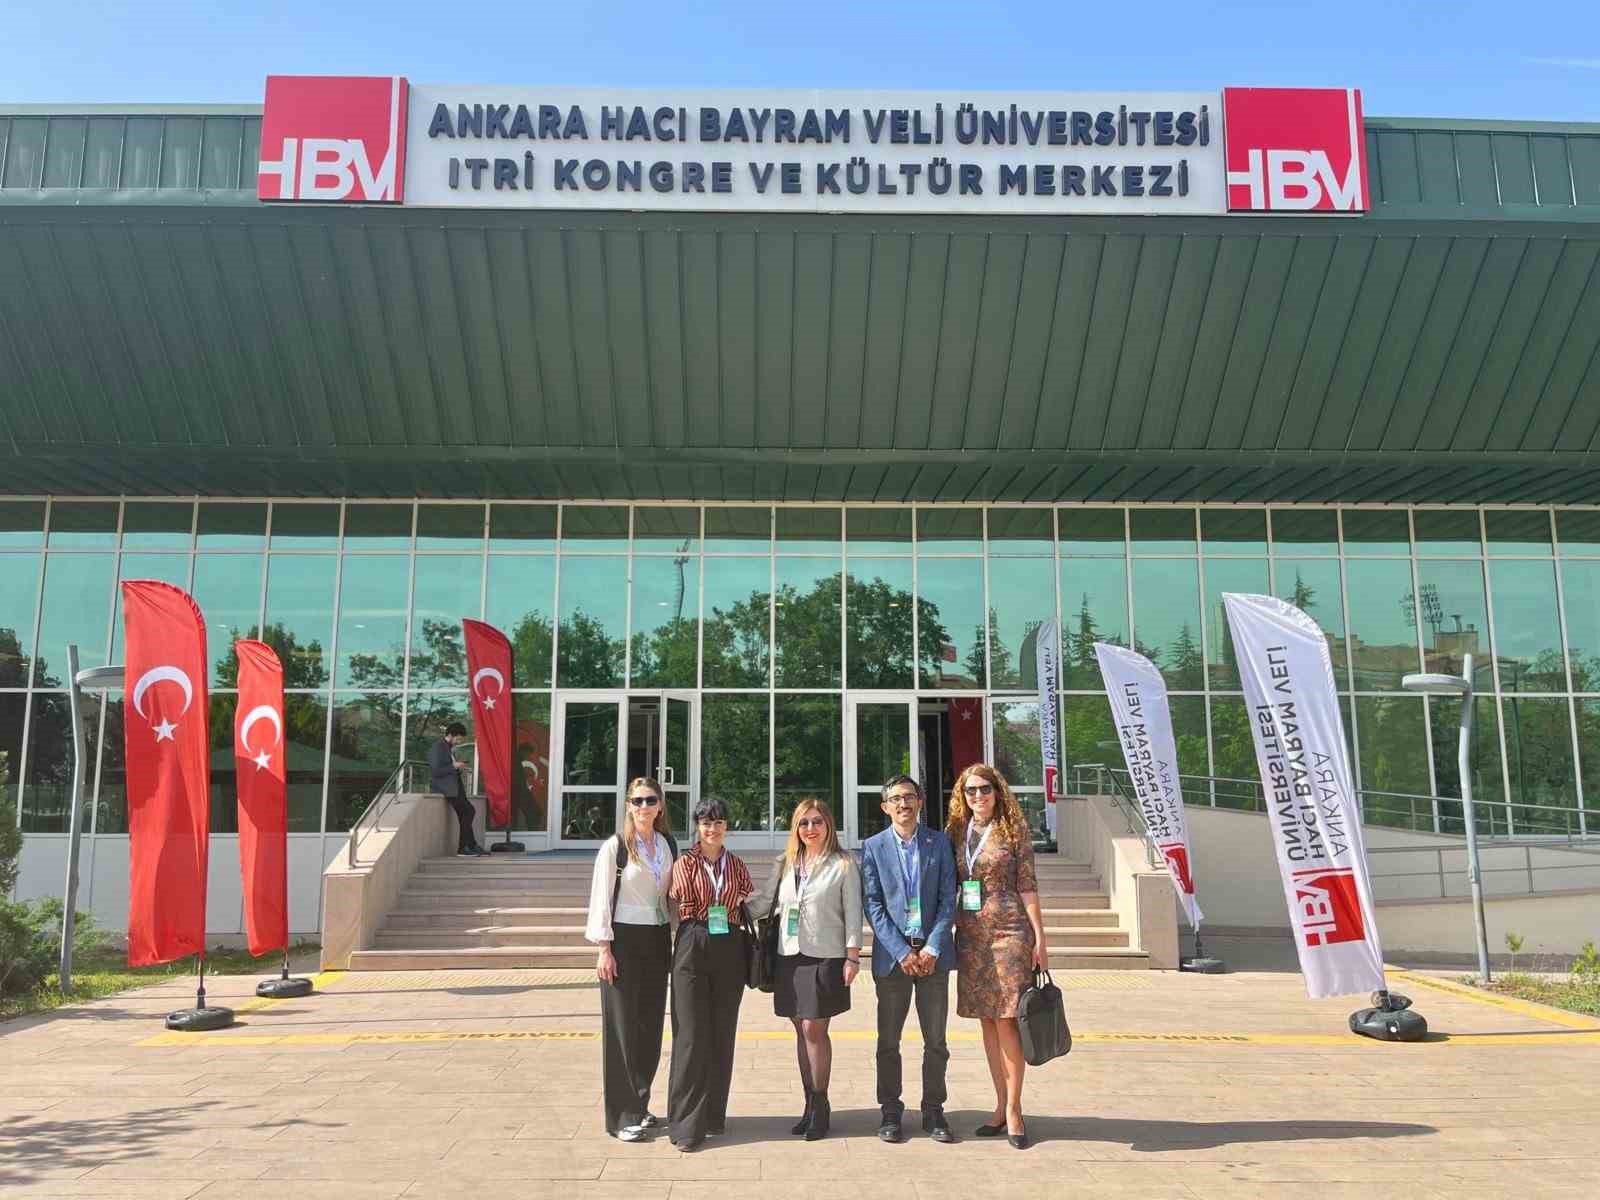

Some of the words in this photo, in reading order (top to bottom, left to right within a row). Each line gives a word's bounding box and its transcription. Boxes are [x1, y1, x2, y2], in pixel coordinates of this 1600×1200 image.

[428, 103, 588, 139] ANKARA
[600, 105, 686, 142] HACI
[699, 107, 851, 145] BAYRAM
[863, 103, 944, 146] VELİ
[956, 103, 1210, 147] ÜNİVERSİTESİ
[554, 157, 733, 193] KONGRE
[749, 160, 802, 194] VE
[816, 156, 983, 196] KÜLTÜR
[1000, 159, 1189, 197] MERKEZİ
